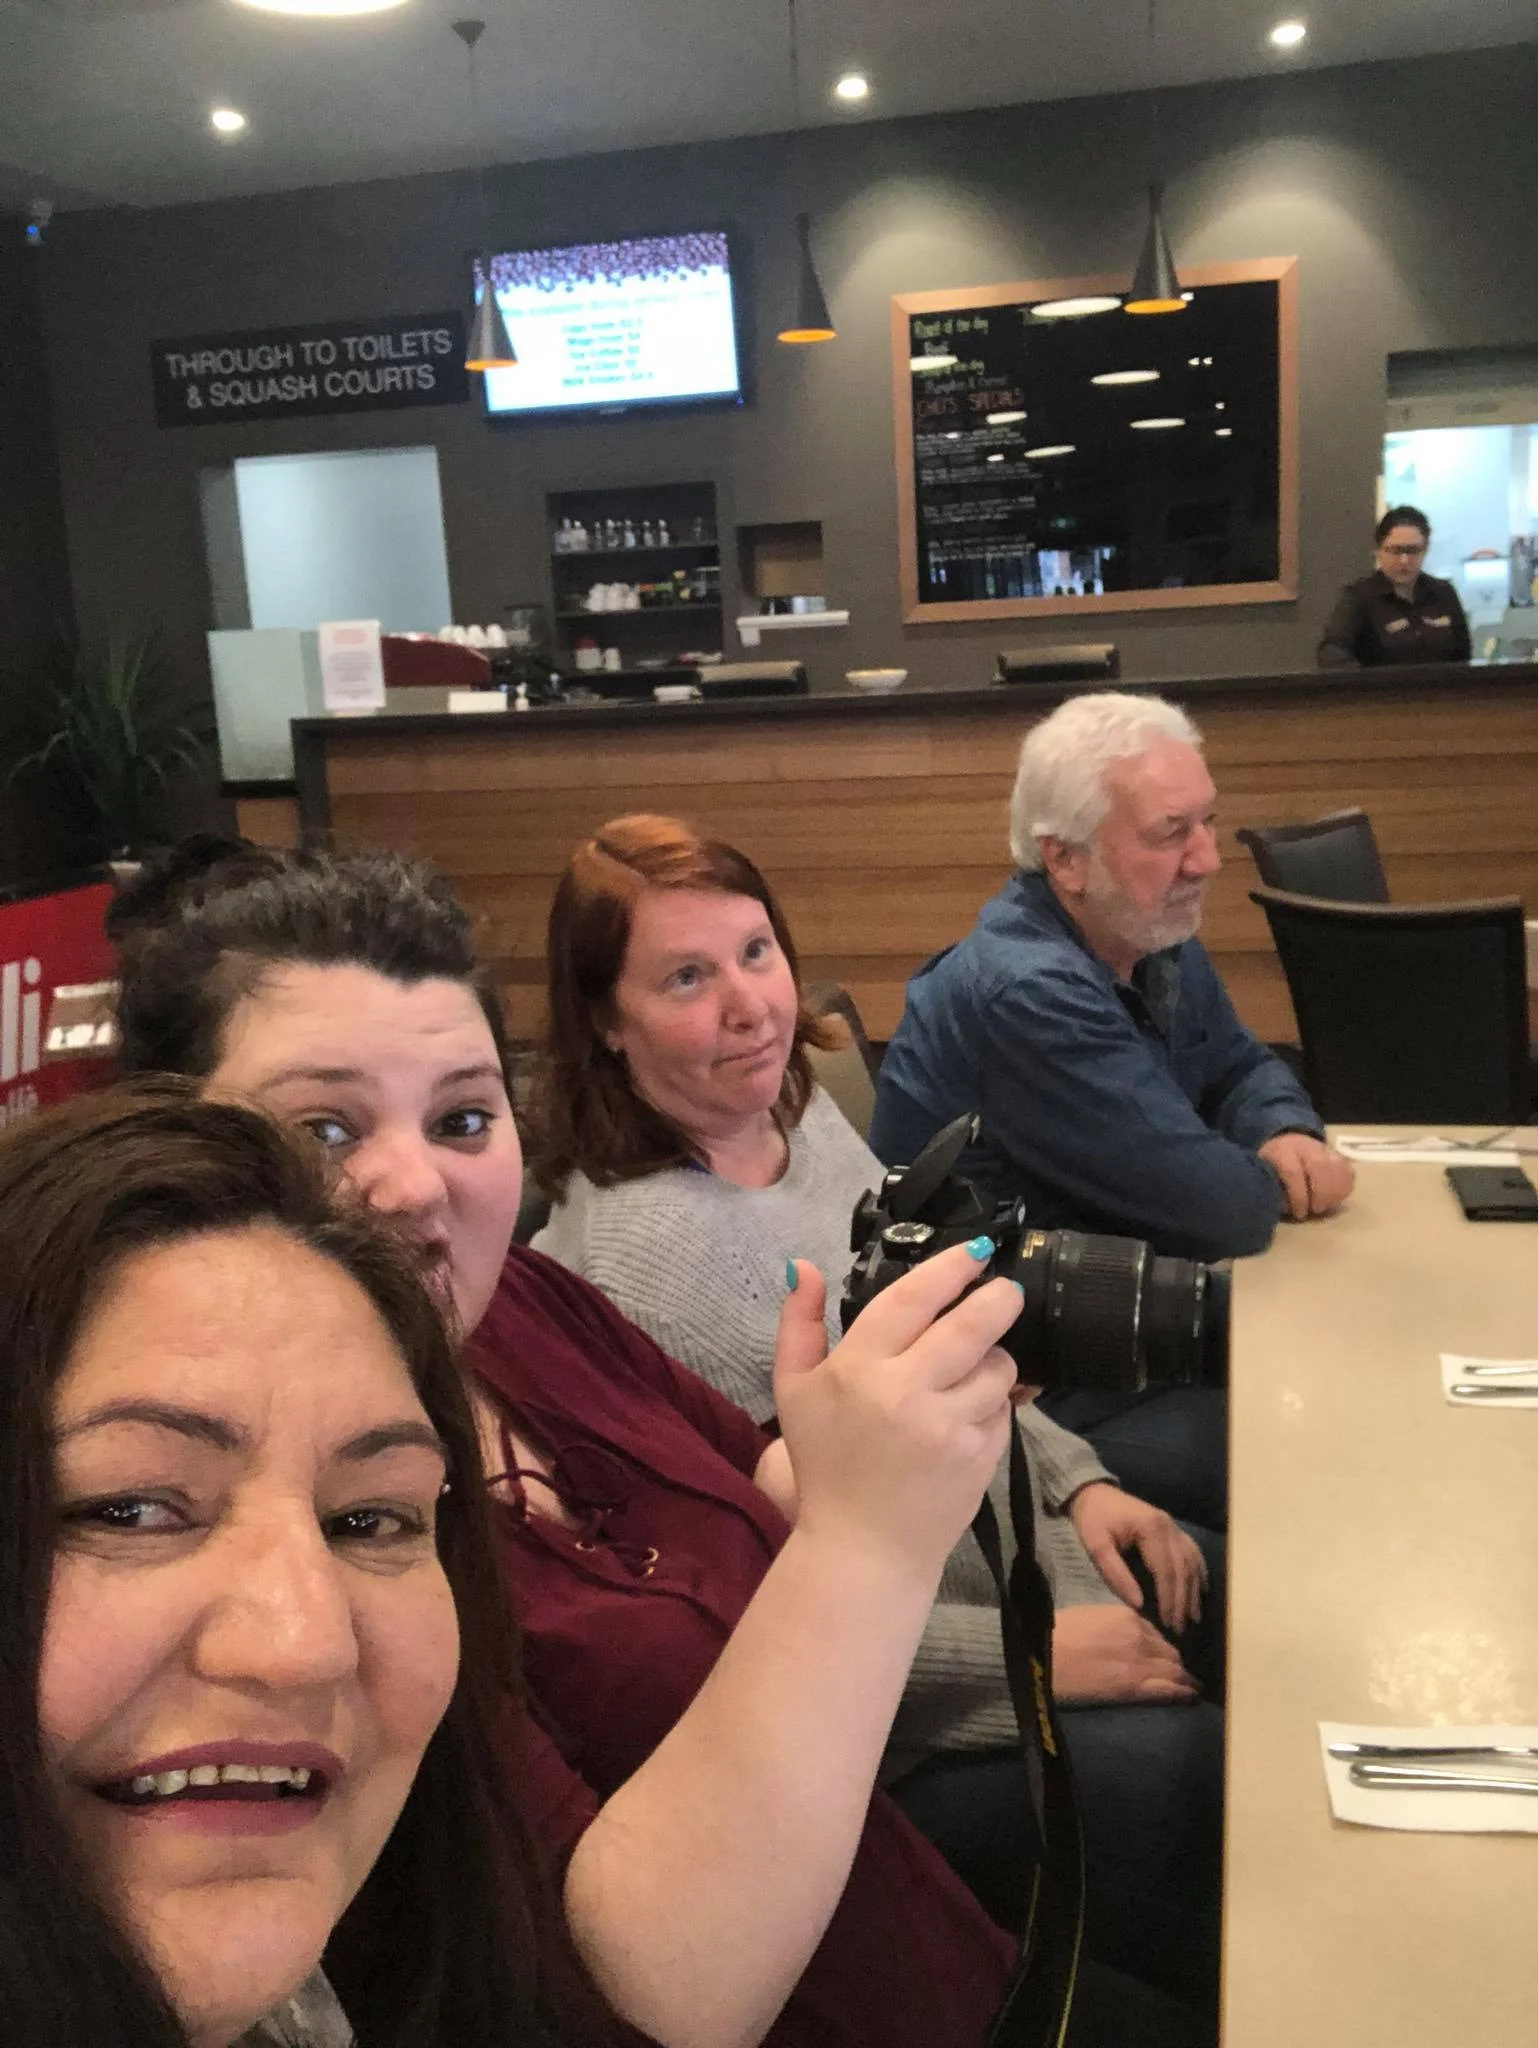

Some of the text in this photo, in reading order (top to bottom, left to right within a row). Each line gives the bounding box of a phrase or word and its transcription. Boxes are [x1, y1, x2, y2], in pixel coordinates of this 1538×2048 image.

[165, 328, 452, 379] THROUGH TO TOILETS
[186, 363, 436, 409] & SQUASH COURTS
